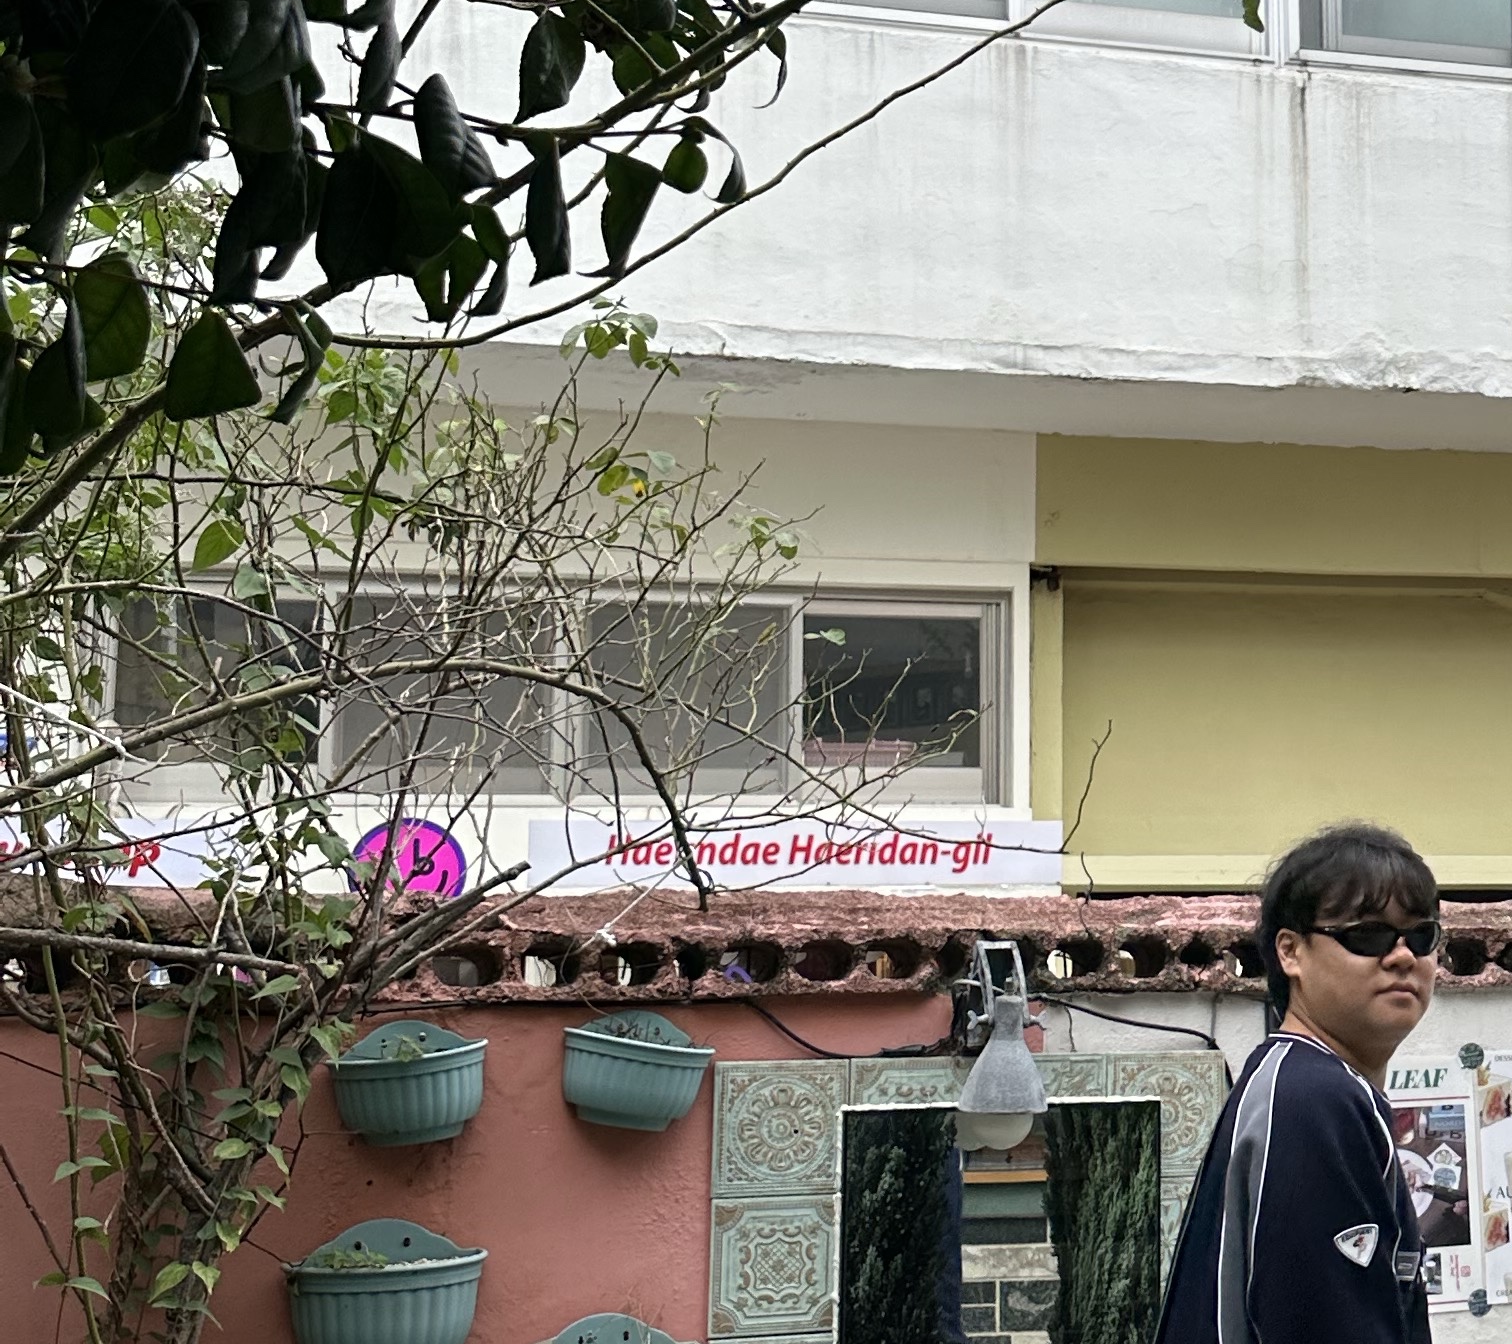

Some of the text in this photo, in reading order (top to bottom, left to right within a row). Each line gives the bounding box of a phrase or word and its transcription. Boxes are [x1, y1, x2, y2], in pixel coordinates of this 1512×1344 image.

[605, 833, 993, 873] Haendae Haeridan-gil
[1389, 1067, 1448, 1090] LEAF
